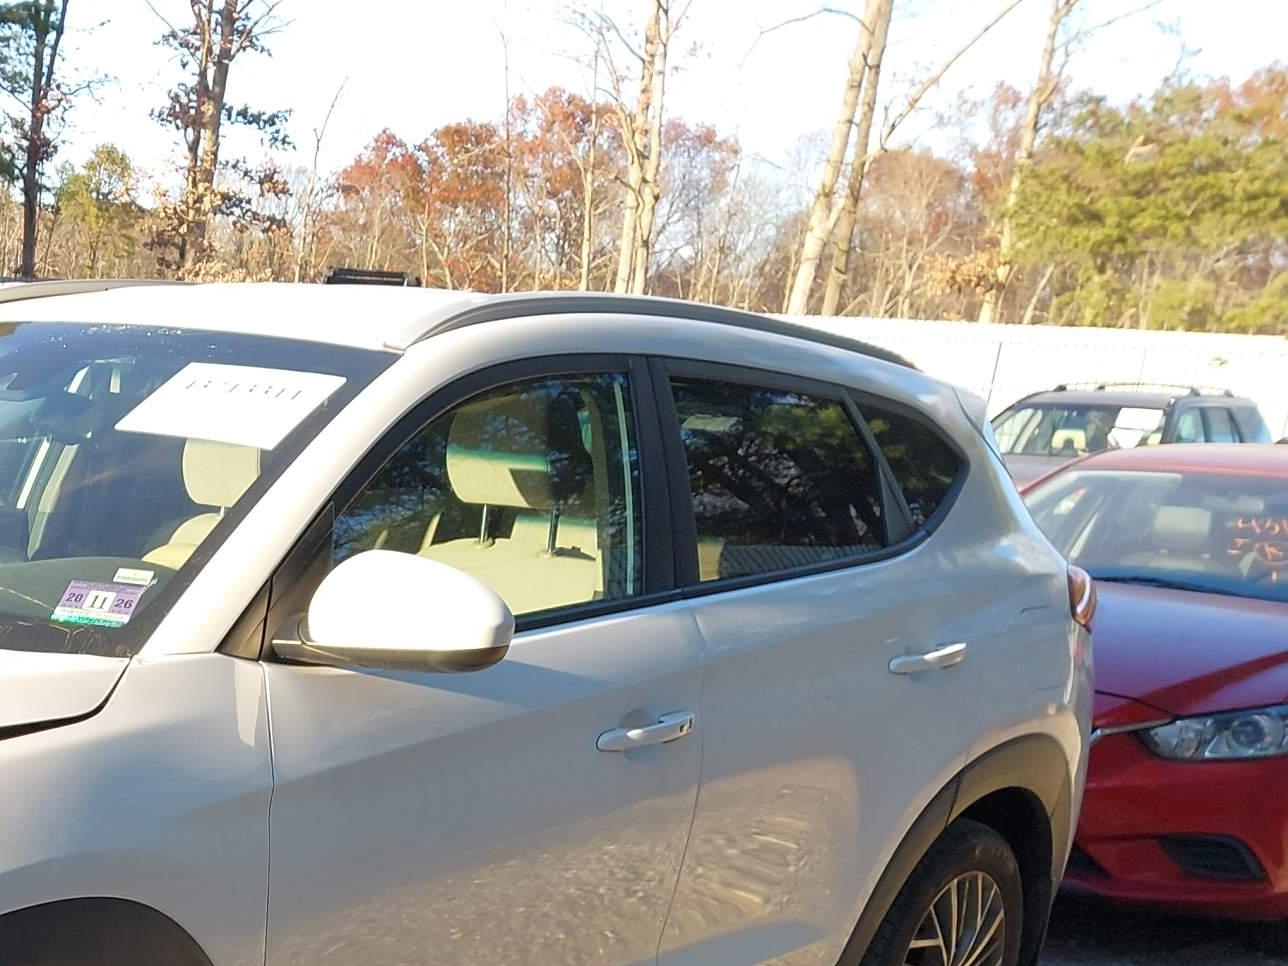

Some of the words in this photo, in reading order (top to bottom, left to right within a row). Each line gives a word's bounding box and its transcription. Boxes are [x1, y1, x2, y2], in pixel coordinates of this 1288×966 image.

[65, 592, 84, 603] 20
[87, 594, 108, 609] 11
[114, 598, 134, 609] 26
